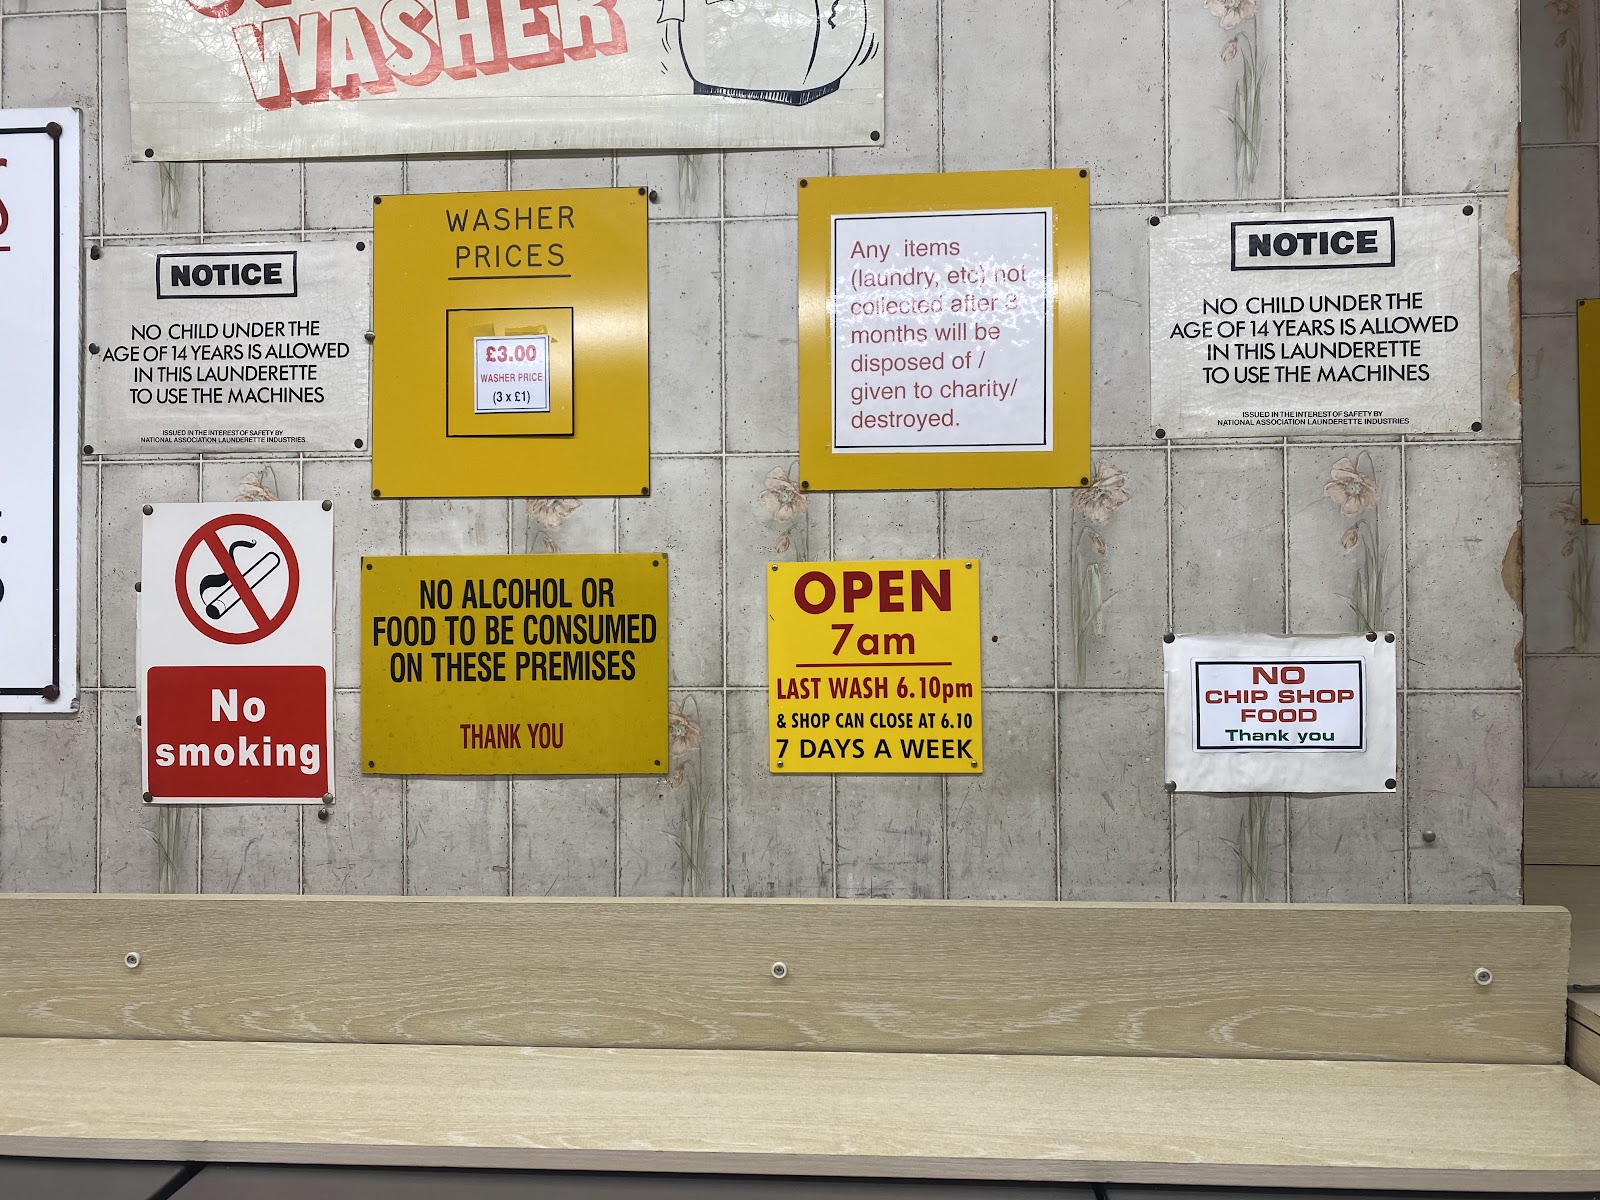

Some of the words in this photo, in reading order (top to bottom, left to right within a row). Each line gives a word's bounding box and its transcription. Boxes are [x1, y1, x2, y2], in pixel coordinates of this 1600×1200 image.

[232, 0, 628, 111] WASHER
[446, 205, 574, 232] WASHER
[851, 241, 890, 262] Any
[904, 240, 960, 257] items
[1249, 230, 1378, 257] NOTICE
[456, 243, 564, 268] PRICES
[171, 263, 282, 286] NOTICE
[851, 268, 939, 291] (laundry,
[947, 265, 986, 287] etc)
[994, 265, 1026, 282] not
[851, 295, 943, 315] collected
[951, 294, 998, 312] after
[1203, 298, 1237, 314] NO
[1246, 296, 1304, 314] CHILD
[1310, 294, 1382, 312] UNDER
[1386, 292, 1422, 309] THE
[131, 325, 161, 340] NO
[168, 323, 218, 339] CHILD
[223, 322, 284, 338] UNDER
[288, 321, 319, 336] THE
[851, 325, 927, 343] months
[935, 323, 967, 341] will
[975, 323, 1000, 340] be
[1170, 322, 1212, 338] AGE
[1217, 321, 1246, 338] OF
[1250, 320, 1269, 336] 14
[1272, 319, 1334, 336] YEARS
[1340, 318, 1356, 335] IS
[1360, 316, 1458, 334] ALLOWED
[103, 346, 139, 362] AGE
[143, 346, 167, 361] OF
[172, 345, 187, 360] 14
[191, 344, 243, 360] YEARS
[248, 344, 262, 359] IS
[265, 343, 349, 359] ALLOWED
[486, 345, 536, 363] £3.00
[1207, 344, 1229, 360] IN
[1234, 343, 1275, 360] THIS
[1282, 340, 1420, 359] LAUNDERETTE
[134, 367, 153, 382] IN
[157, 367, 192, 382] THIS
[197, 365, 317, 381] LAUNDERETTE
[851, 352, 944, 376] disposed
[952, 351, 971, 369] of
[978, 351, 985, 368] /
[1203, 367, 1229, 384] TO
[1234, 366, 1269, 383] USE
[1274, 366, 1311, 382] THE
[1317, 364, 1430, 382] MACHINES
[481, 373, 515, 382] WASHER
[518, 373, 542, 381] PRICE
[130, 389, 152, 404] TO
[157, 389, 187, 404] USE
[192, 388, 222, 403] THE
[228, 387, 324, 403] MACHINES
[493, 391, 503, 405] (3
[506, 394, 512, 402] x
[514, 391, 530, 403] £1)
[851, 382, 906, 405] given
[914, 382, 932, 399] to
[940, 378, 1017, 401] charity/
[851, 409, 960, 432] destroyed.
[420, 579, 452, 609] NO
[461, 578, 572, 609] ALCOHOL
[581, 578, 615, 608] OR
[794, 569, 951, 614] OPEN
[373, 616, 436, 646] FOOD
[445, 615, 475, 645] TO
[486, 615, 514, 645] BE
[523, 614, 657, 645] CONSUMED
[831, 623, 915, 656] 7am
[390, 653, 422, 683] ON
[432, 652, 506, 682] THESE
[516, 650, 636, 681] PREMISES
[1253, 666, 1305, 685] NO
[777, 678, 821, 699] LAST
[829, 677, 888, 698] WASH
[897, 676, 973, 703] 6.10pm
[1205, 690, 1268, 704] CHIP
[1278, 689, 1354, 703] SHOP
[212, 689, 265, 722] No
[1241, 709, 1317, 723] FOOD
[777, 714, 786, 729] &
[792, 713, 830, 728] SHOP
[835, 713, 864, 728] CAN
[870, 713, 913, 729] CLOSE
[918, 713, 935, 728] AT
[941, 713, 972, 729] 6.10
[460, 724, 521, 749] THANK
[527, 723, 564, 748] YOU
[1225, 729, 1289, 741] Thank
[1297, 732, 1334, 743] you
[156, 736, 320, 775] smoking
[776, 739, 789, 759] 7
[800, 739, 865, 759] DAYS
[874, 739, 892, 759] A
[900, 738, 972, 759] WEEK
